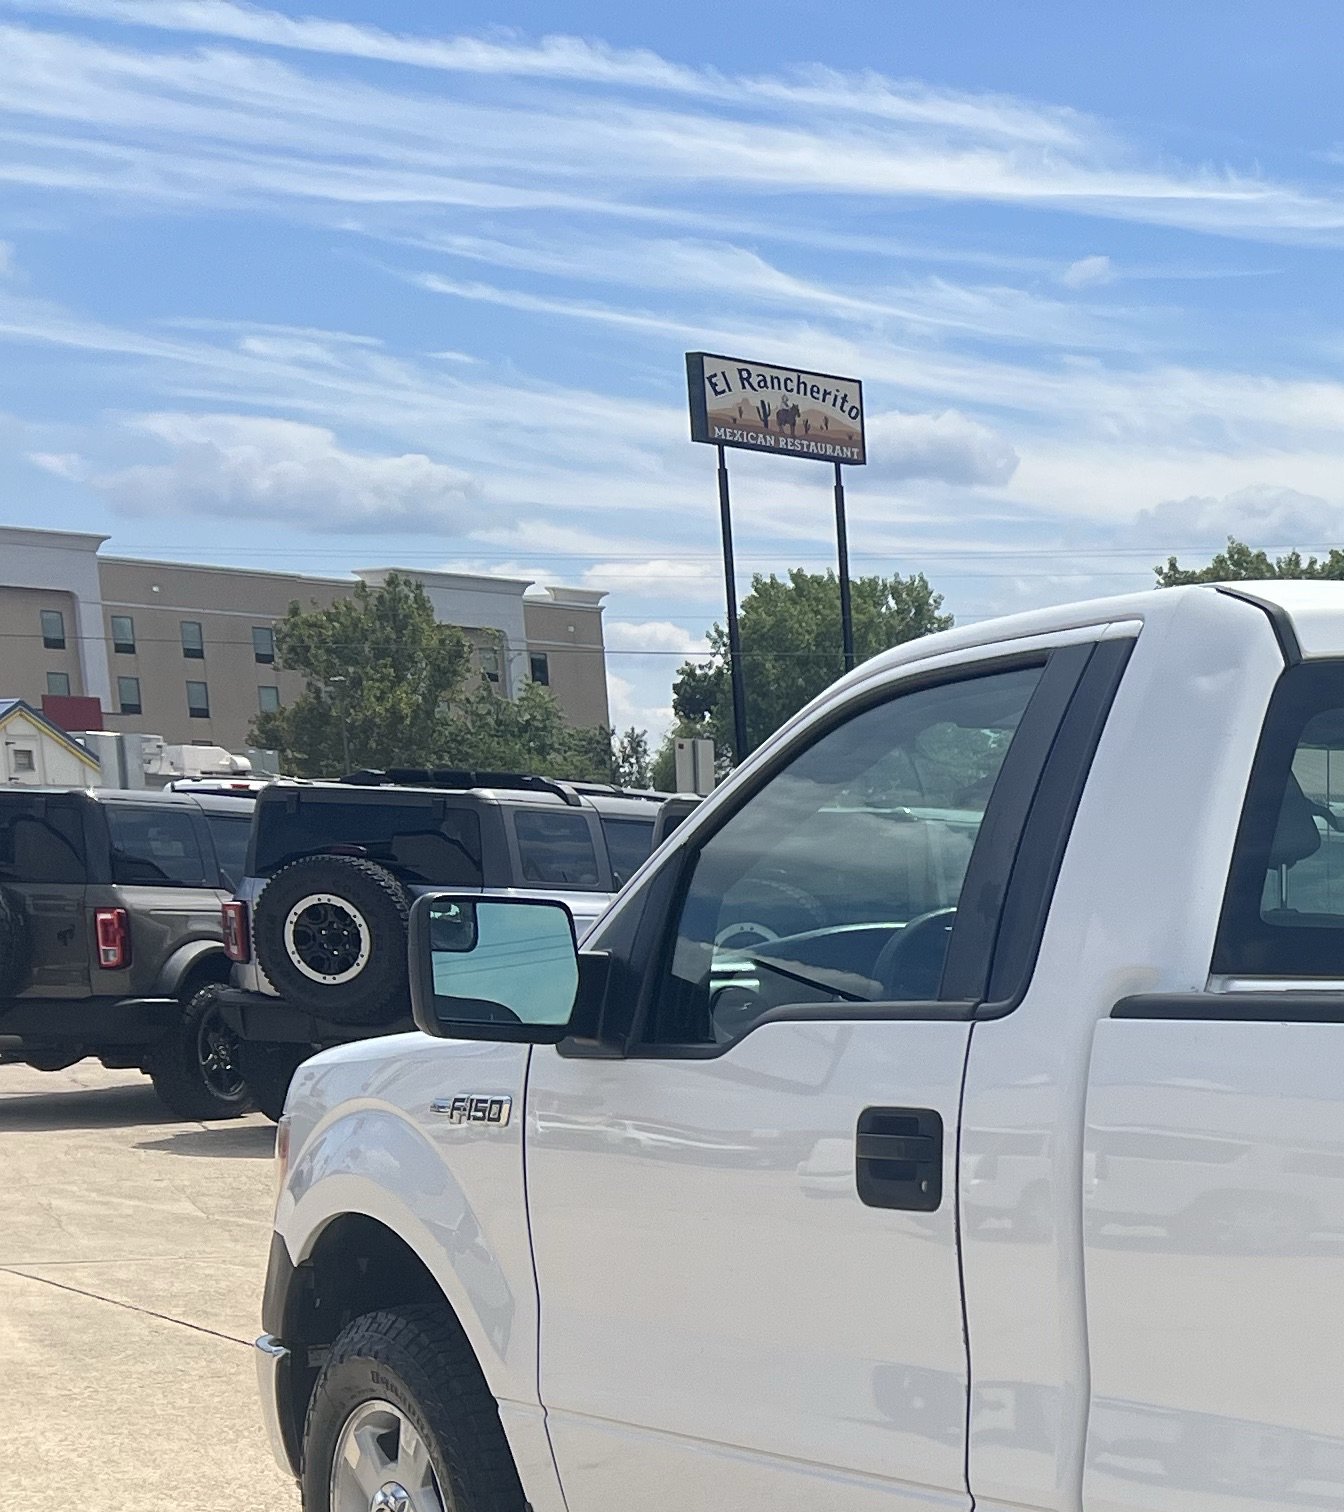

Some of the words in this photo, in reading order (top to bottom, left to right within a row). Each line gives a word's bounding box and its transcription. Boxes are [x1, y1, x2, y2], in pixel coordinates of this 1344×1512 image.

[706, 370, 732, 397] El
[737, 367, 860, 421] Rancherito
[713, 426, 775, 447] MEXICAN
[779, 436, 860, 460] RESTAURANT
